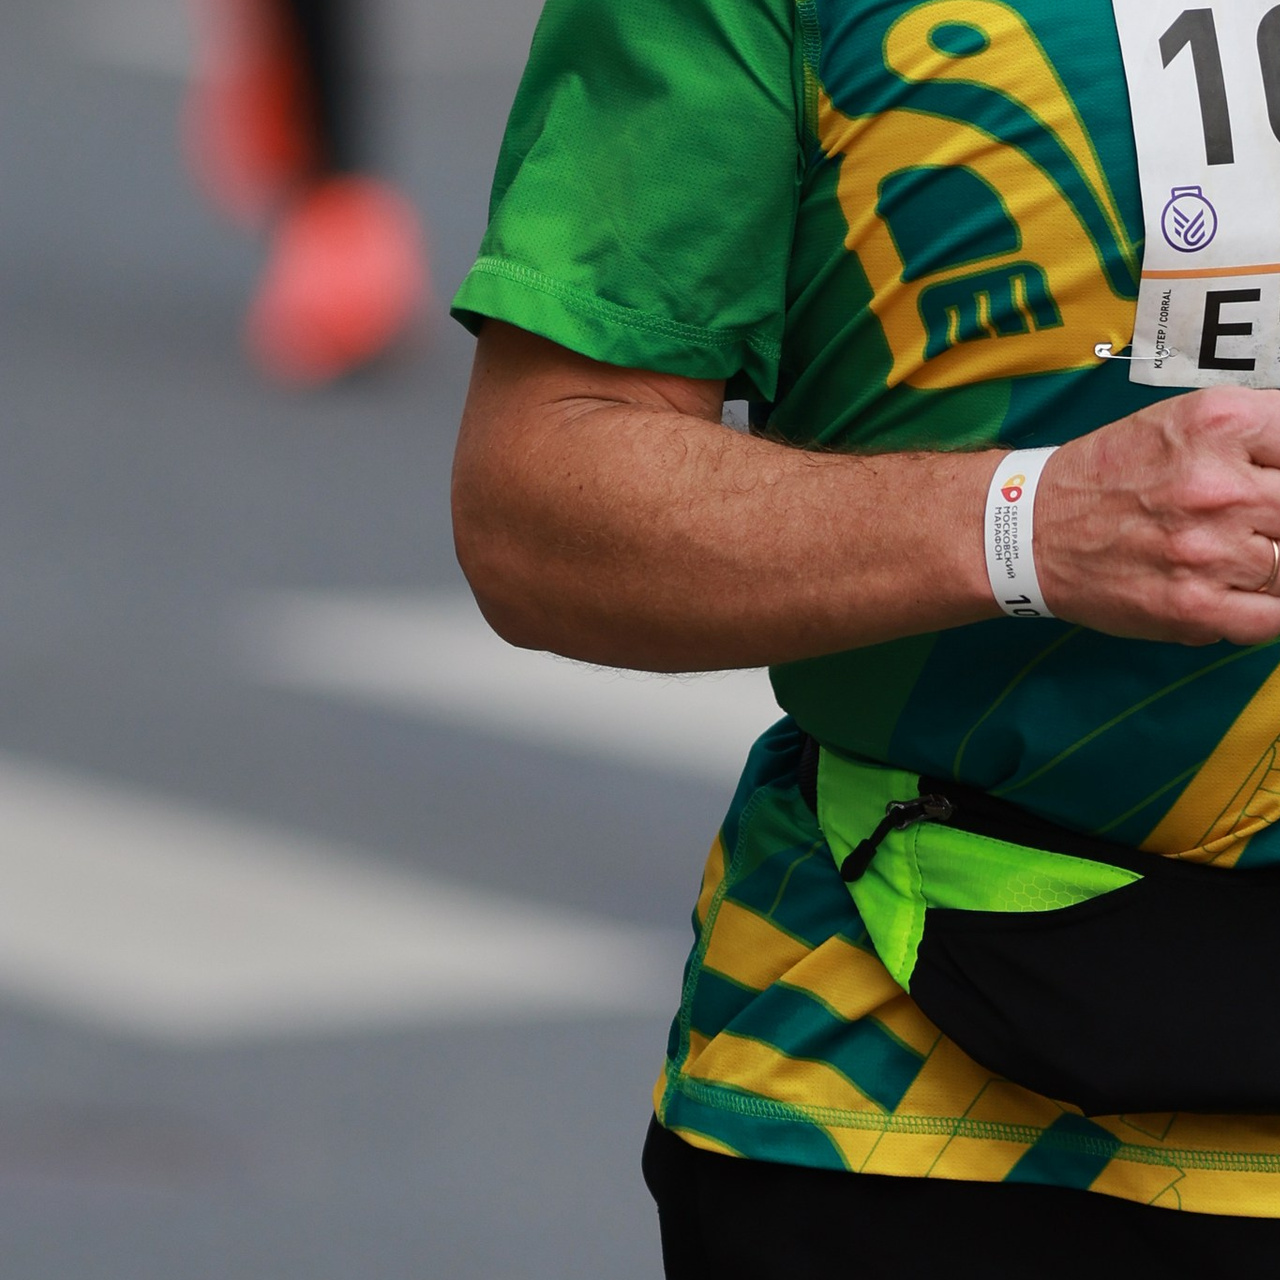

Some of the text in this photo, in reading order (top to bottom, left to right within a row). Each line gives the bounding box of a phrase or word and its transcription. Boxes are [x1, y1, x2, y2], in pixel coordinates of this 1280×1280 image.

[1159, 289, 1172, 323] CORRAL
[994, 506, 1004, 561] МАРАФОН
[1002, 505, 1017, 579] МОСКОВСКИЙ
[1011, 505, 1020, 560] СБЕРПРАЙМ
